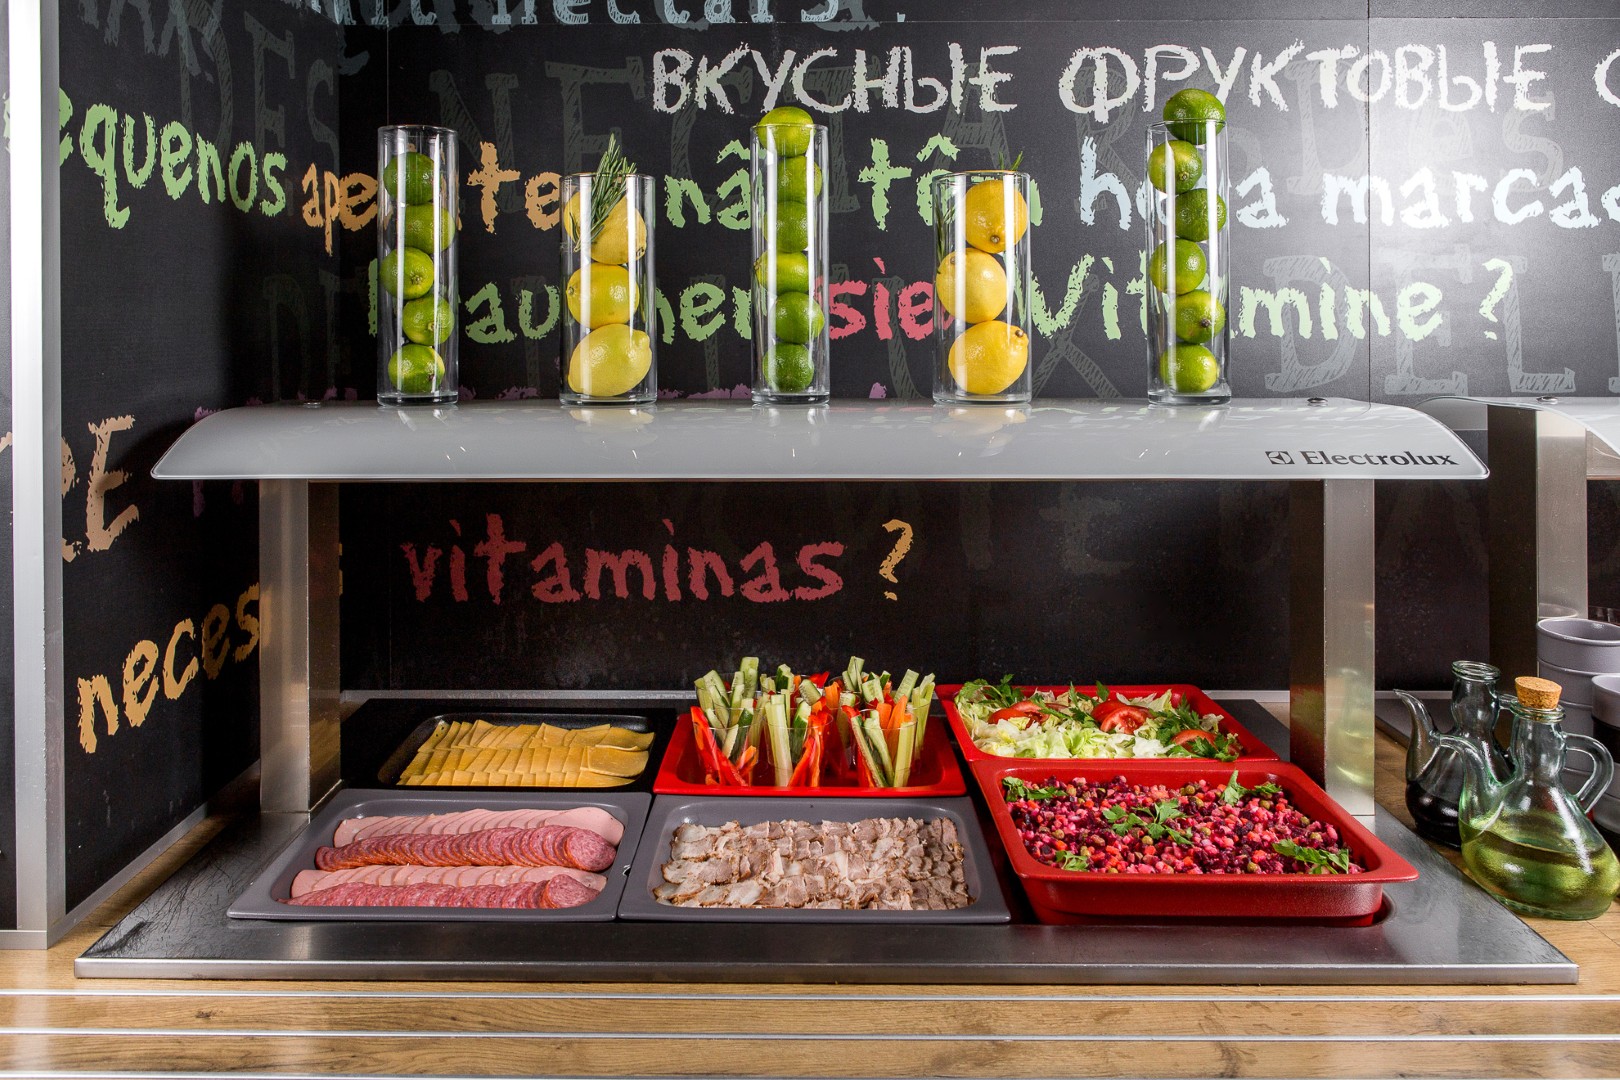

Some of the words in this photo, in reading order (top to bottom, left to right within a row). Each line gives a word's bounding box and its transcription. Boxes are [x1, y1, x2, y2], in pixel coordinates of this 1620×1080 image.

[652, 42, 1021, 115] ВКУСНЫЕ
[1299, 450, 1460, 466] Electrolux
[401, 512, 848, 604] vitaminas
[77, 582, 261, 754] neces
